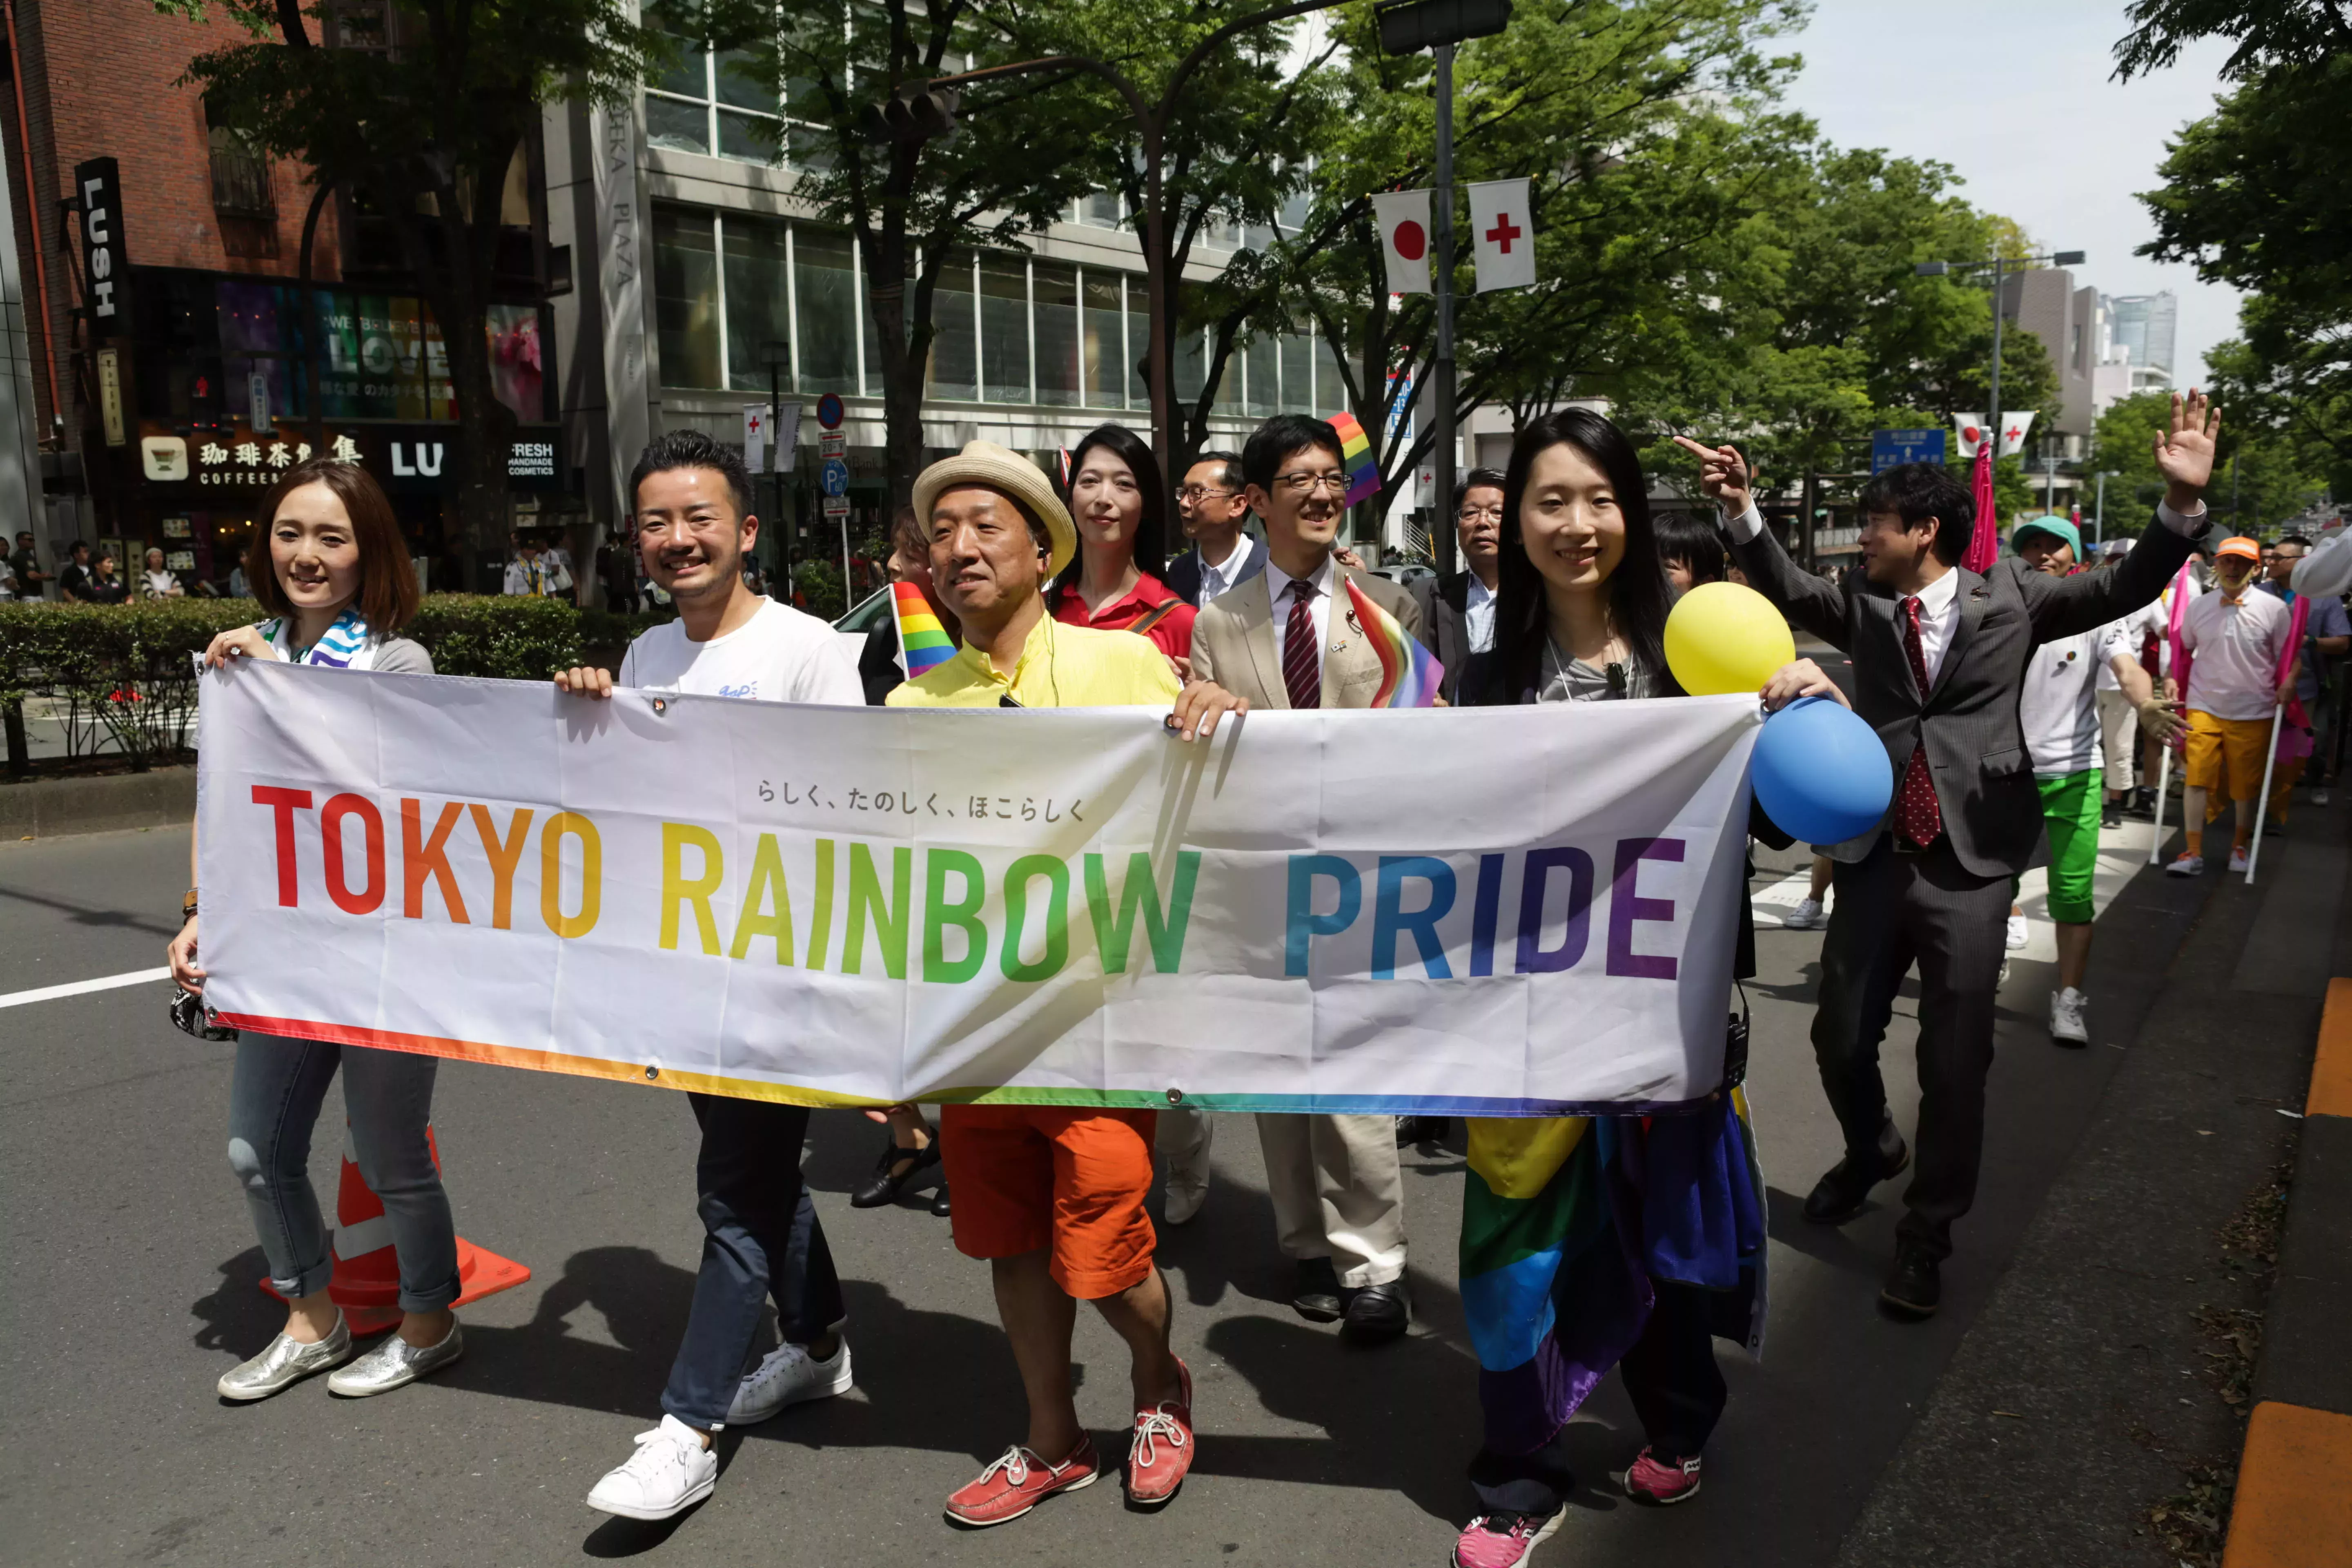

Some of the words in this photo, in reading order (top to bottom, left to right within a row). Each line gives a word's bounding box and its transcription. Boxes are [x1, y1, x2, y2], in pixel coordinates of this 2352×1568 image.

[84, 177, 115, 317] LUSH
[613, 202, 633, 288] PLAZA
[329, 334, 450, 376] LOVE
[391, 442, 443, 477] LU
[508, 458, 553, 466] HANDMADE
[508, 467, 554, 476] COSMETICS
[827, 470, 837, 492] P
[835, 482, 842, 492] 60
[758, 780, 1086, 823] らしく、たのしく、ほこらしく
[251, 784, 602, 939] TOKYO
[658, 821, 1202, 984] RAINBOW
[1284, 837, 1686, 981] PRIDE
